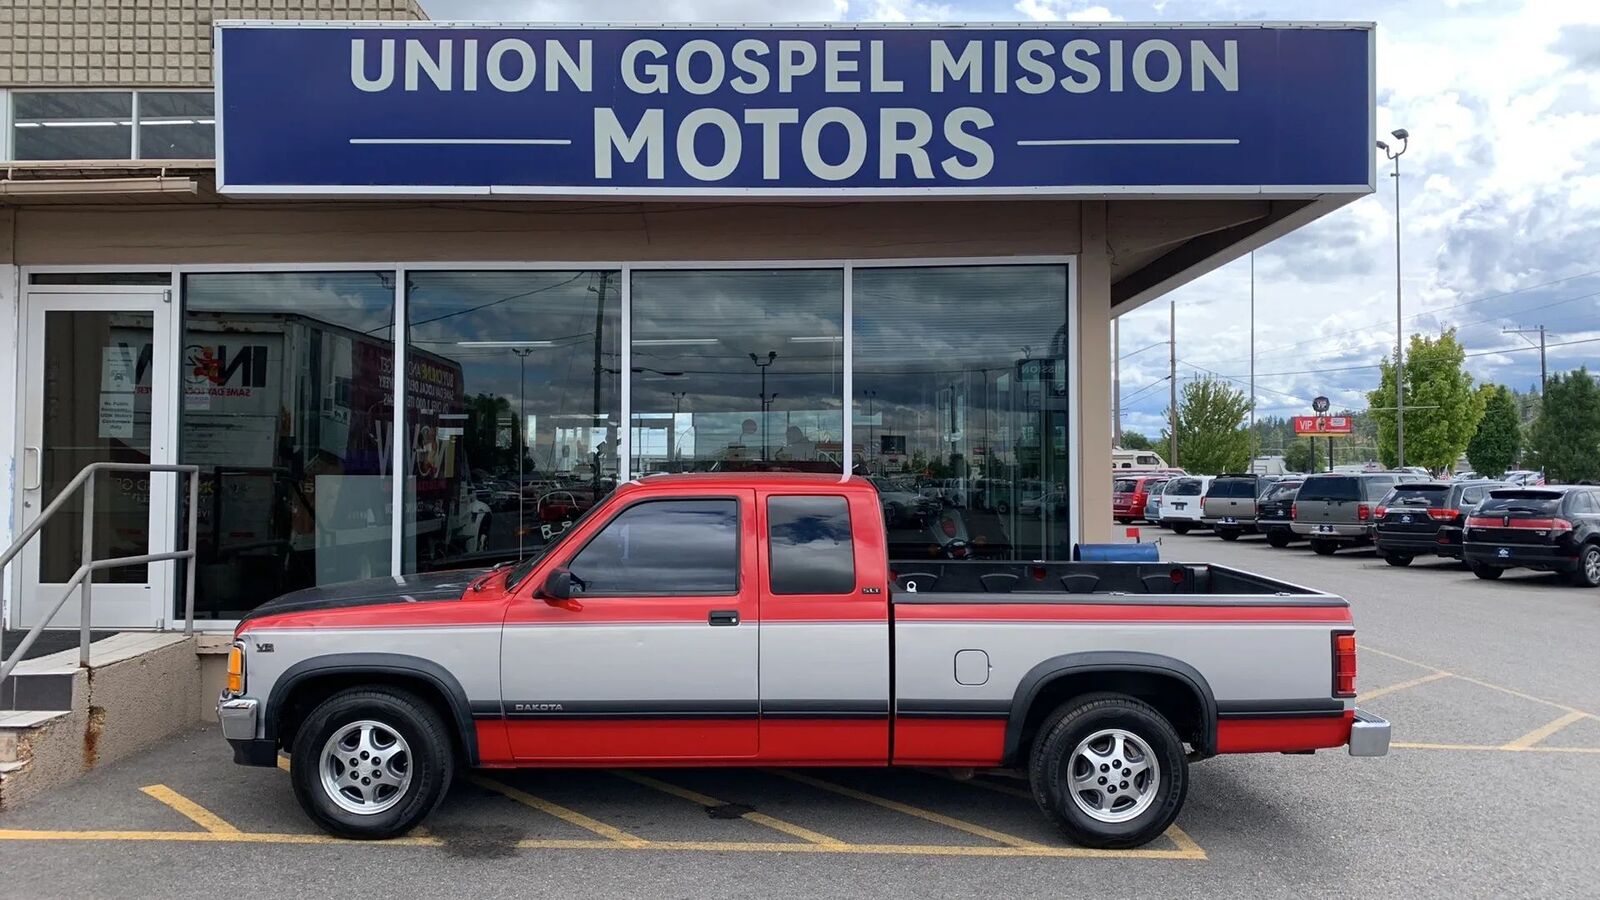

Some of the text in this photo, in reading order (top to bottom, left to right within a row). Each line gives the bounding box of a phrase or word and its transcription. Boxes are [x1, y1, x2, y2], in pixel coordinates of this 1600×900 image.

[350, 38, 1239, 95] UNION GOSPEL MISSION
[594, 106, 995, 182] MOTORS
[1299, 420, 1313, 430] VIP
[515, 703, 563, 711] DAKOTA
